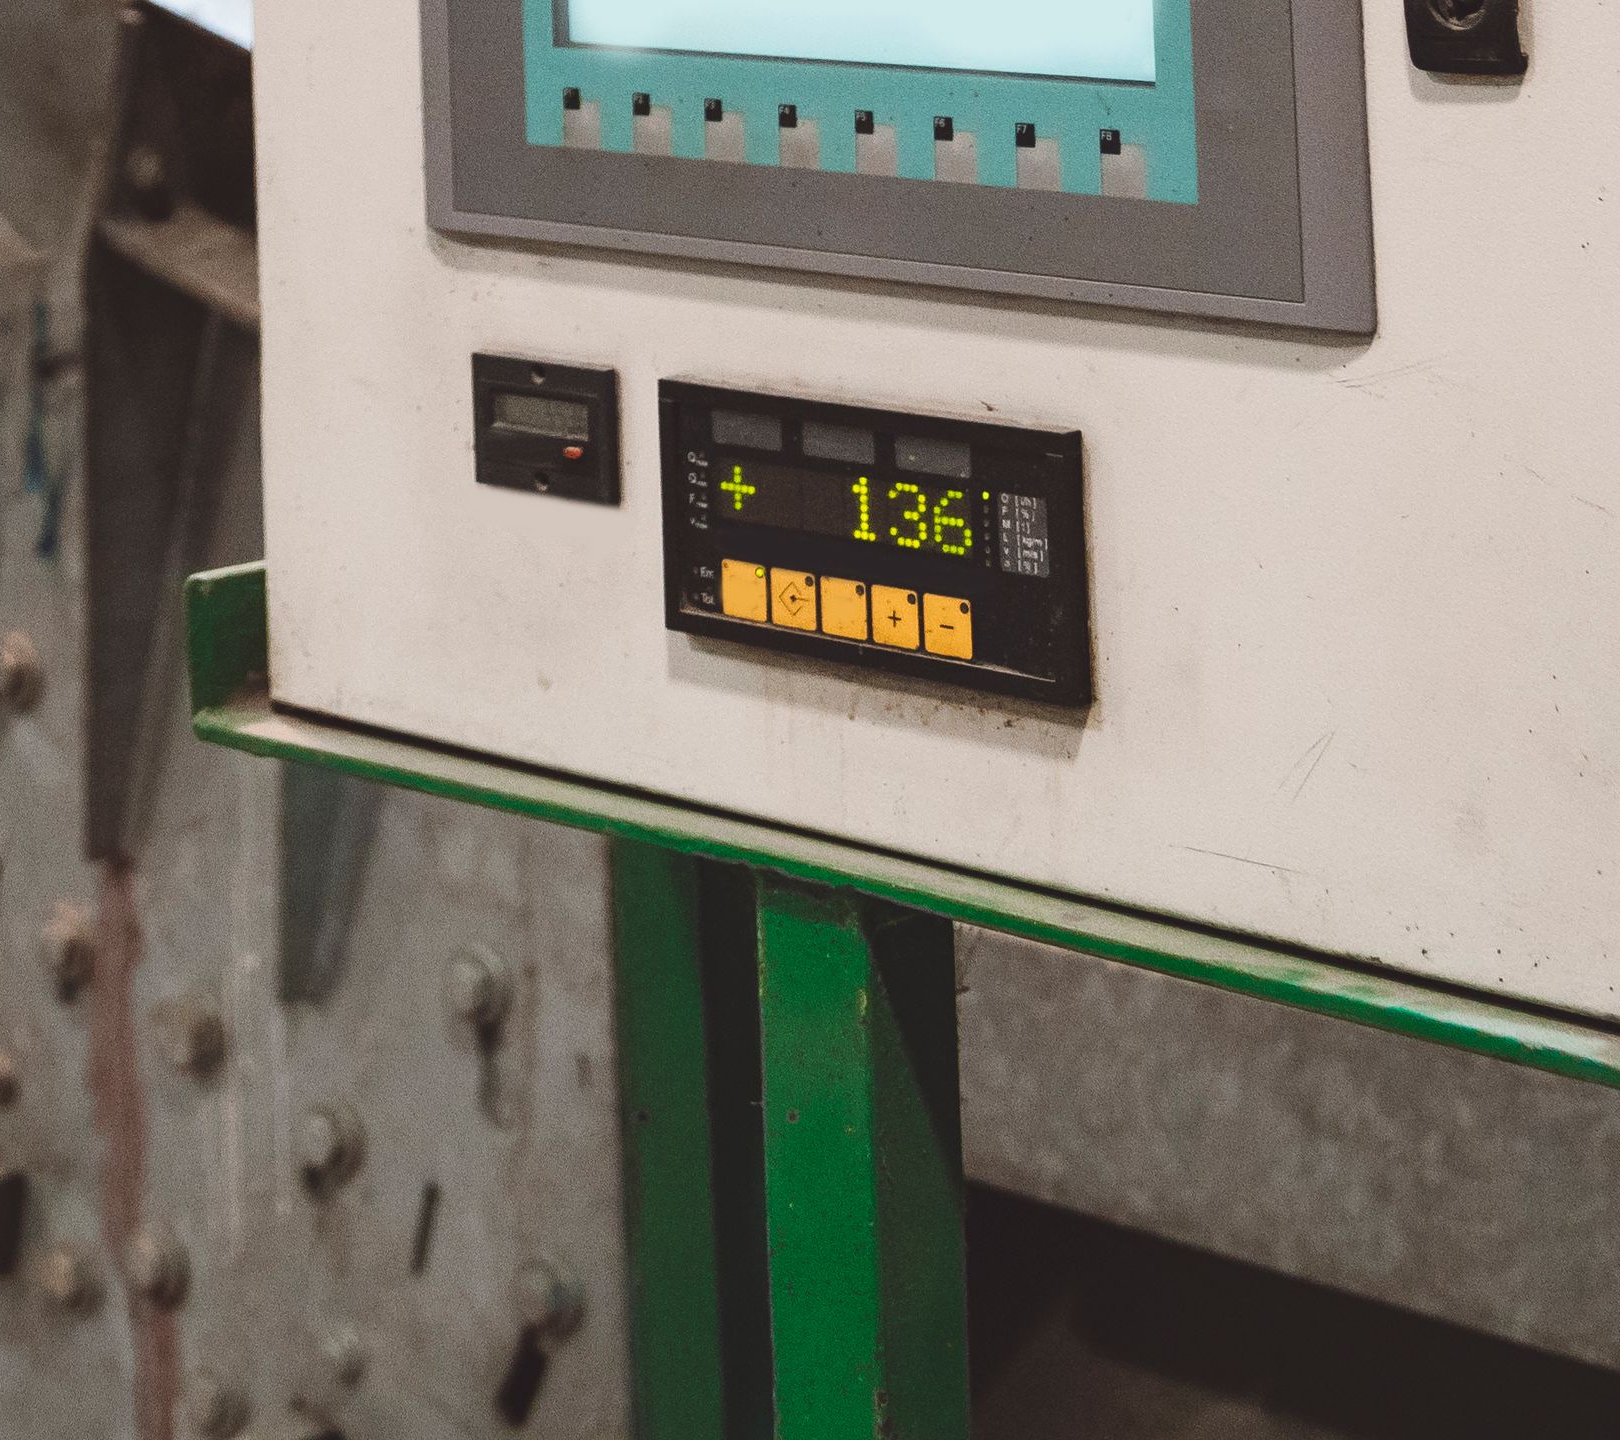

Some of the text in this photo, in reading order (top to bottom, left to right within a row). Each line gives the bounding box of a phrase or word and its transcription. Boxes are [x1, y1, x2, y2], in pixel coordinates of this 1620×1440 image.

[1016, 124, 1027, 134] F7
[1101, 131, 1112, 141] F8
[852, 476, 973, 555] 136
